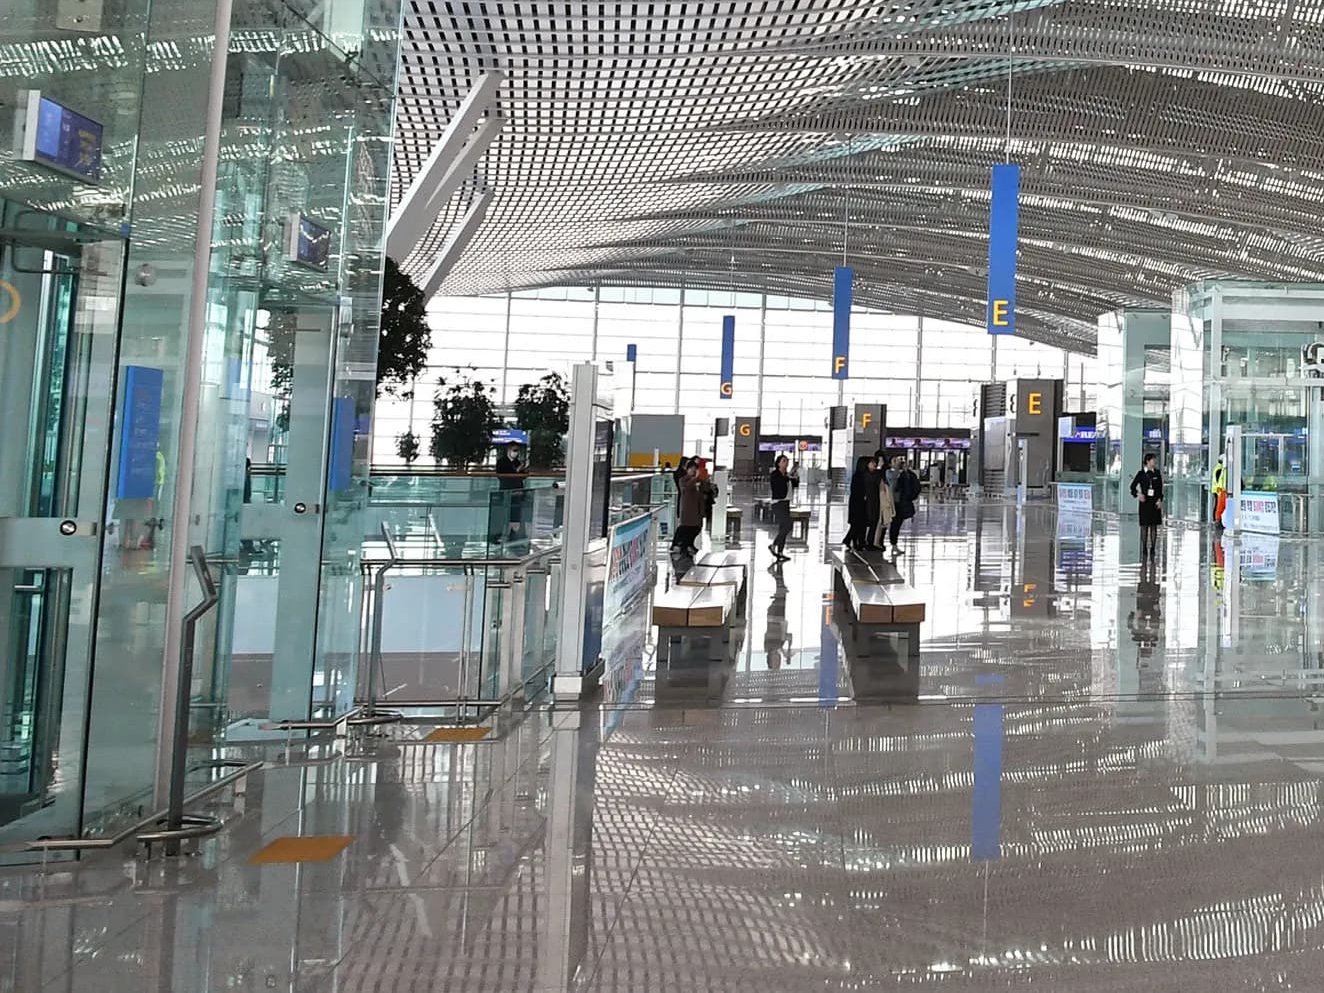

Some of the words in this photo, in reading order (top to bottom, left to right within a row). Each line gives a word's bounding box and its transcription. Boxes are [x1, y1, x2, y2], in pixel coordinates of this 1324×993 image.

[993, 299, 1009, 326] E
[834, 356, 846, 374] F
[721, 382, 733, 396] G
[1028, 392, 1042, 415] E
[862, 412, 872, 429] F
[739, 423, 750, 437] G
